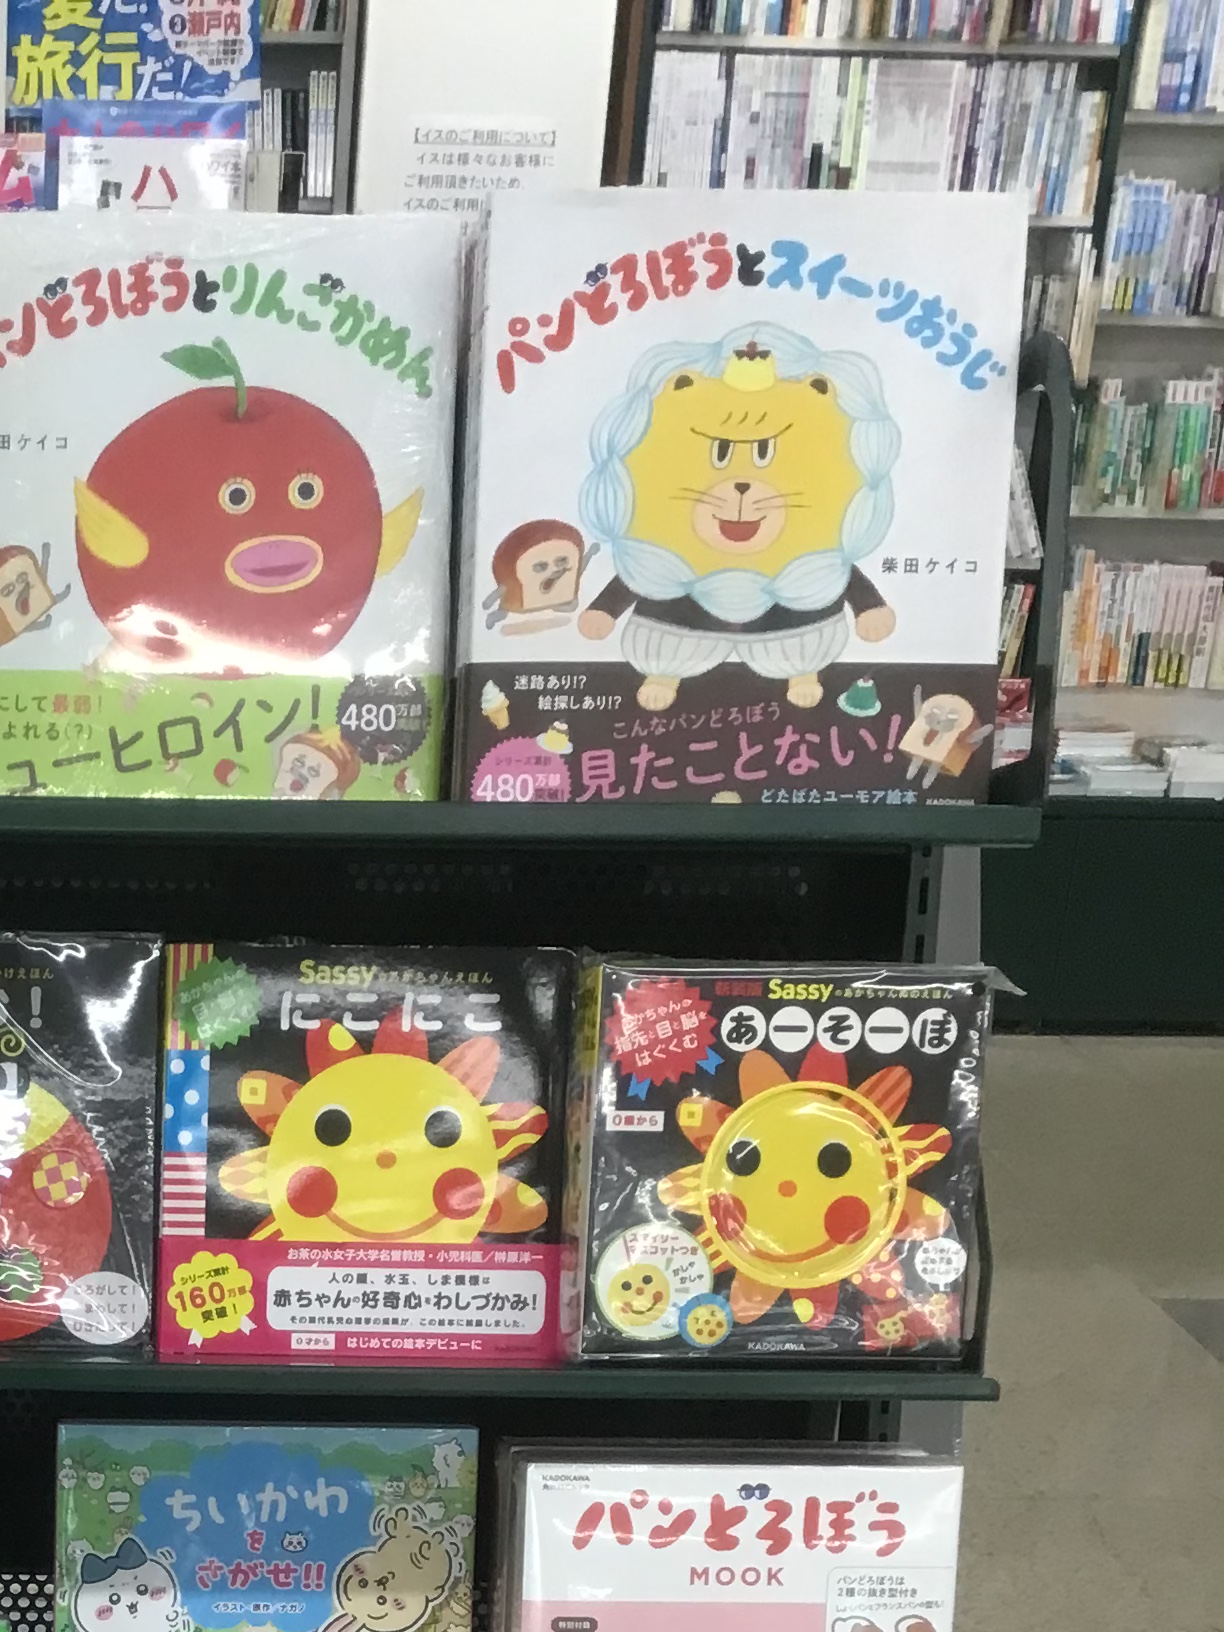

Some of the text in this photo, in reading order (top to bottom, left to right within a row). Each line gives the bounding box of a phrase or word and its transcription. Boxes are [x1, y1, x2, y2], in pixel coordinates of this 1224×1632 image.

[496, 232, 1008, 395] パンどろぼうとスイーツおうじ
[881, 556, 980, 576] 柴田ケイコ
[513, 673, 588, 692] 迷路あり!?
[538, 692, 624, 711] 絵探しあり!?
[612, 702, 782, 740] こんなパンどろぼう
[577, 714, 902, 802] 見たことない!
[299, 958, 377, 988] Sassy
[767, 977, 835, 1003] Sassy
[279, 990, 503, 1032] にこにこ
[722, 1006, 958, 1054] あーそーぼ
[635, 1033, 699, 1067] はぐくむ
[273, 1288, 539, 1312] 赤ちゃんの好奇心をわしづかみ!
[346, 1335, 483, 1352] はじめての絵本デビューに
[165, 1477, 349, 1533] ちいかわ
[572, 1488, 908, 1558] パンどろぼう
[246, 1529, 266, 1554] を
[196, 1558, 327, 1592] さがせ!!
[689, 1566, 785, 1587] MOOK
[835, 1574, 906, 1587] パンどろぼうは
